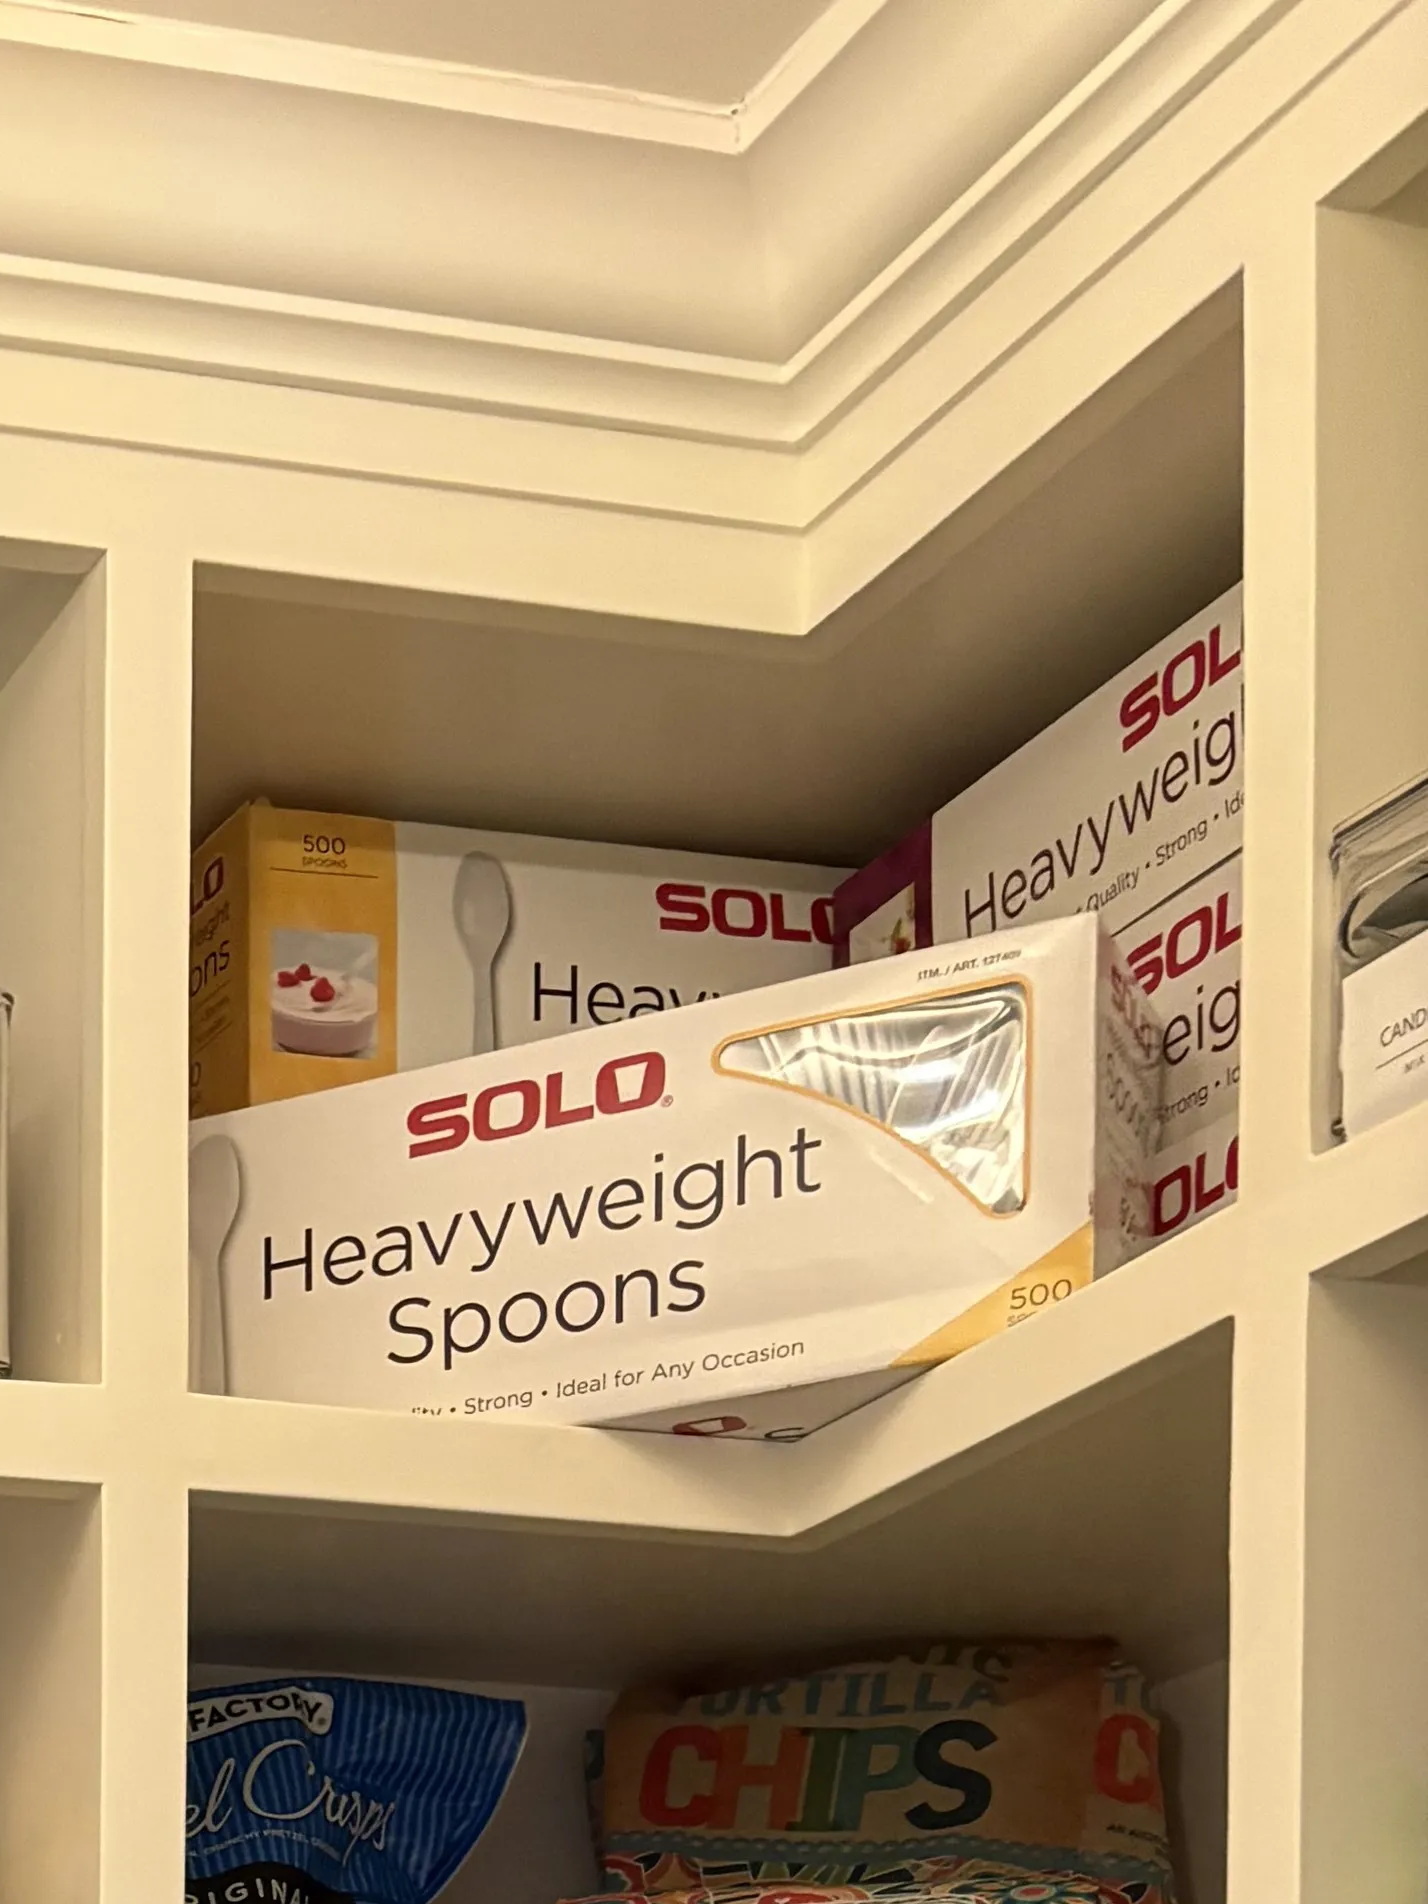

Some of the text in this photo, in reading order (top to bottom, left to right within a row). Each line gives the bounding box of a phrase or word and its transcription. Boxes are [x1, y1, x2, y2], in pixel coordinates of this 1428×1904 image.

[303, 835, 345, 855] 500
[964, 711, 1244, 935] Heavyweig
[1155, 819, 1209, 867] Strong
[406, 1051, 666, 1160] SOLO
[262, 1126, 823, 1300] Heavyweight
[387, 1259, 707, 1371] Spoons
[1008, 1278, 1073, 1310] 500
[464, 1337, 805, 1418] Strong Ideal for Any Occasion
[189, 1692, 323, 1733] FACTORY
[639, 1718, 999, 1834] CHIPS
